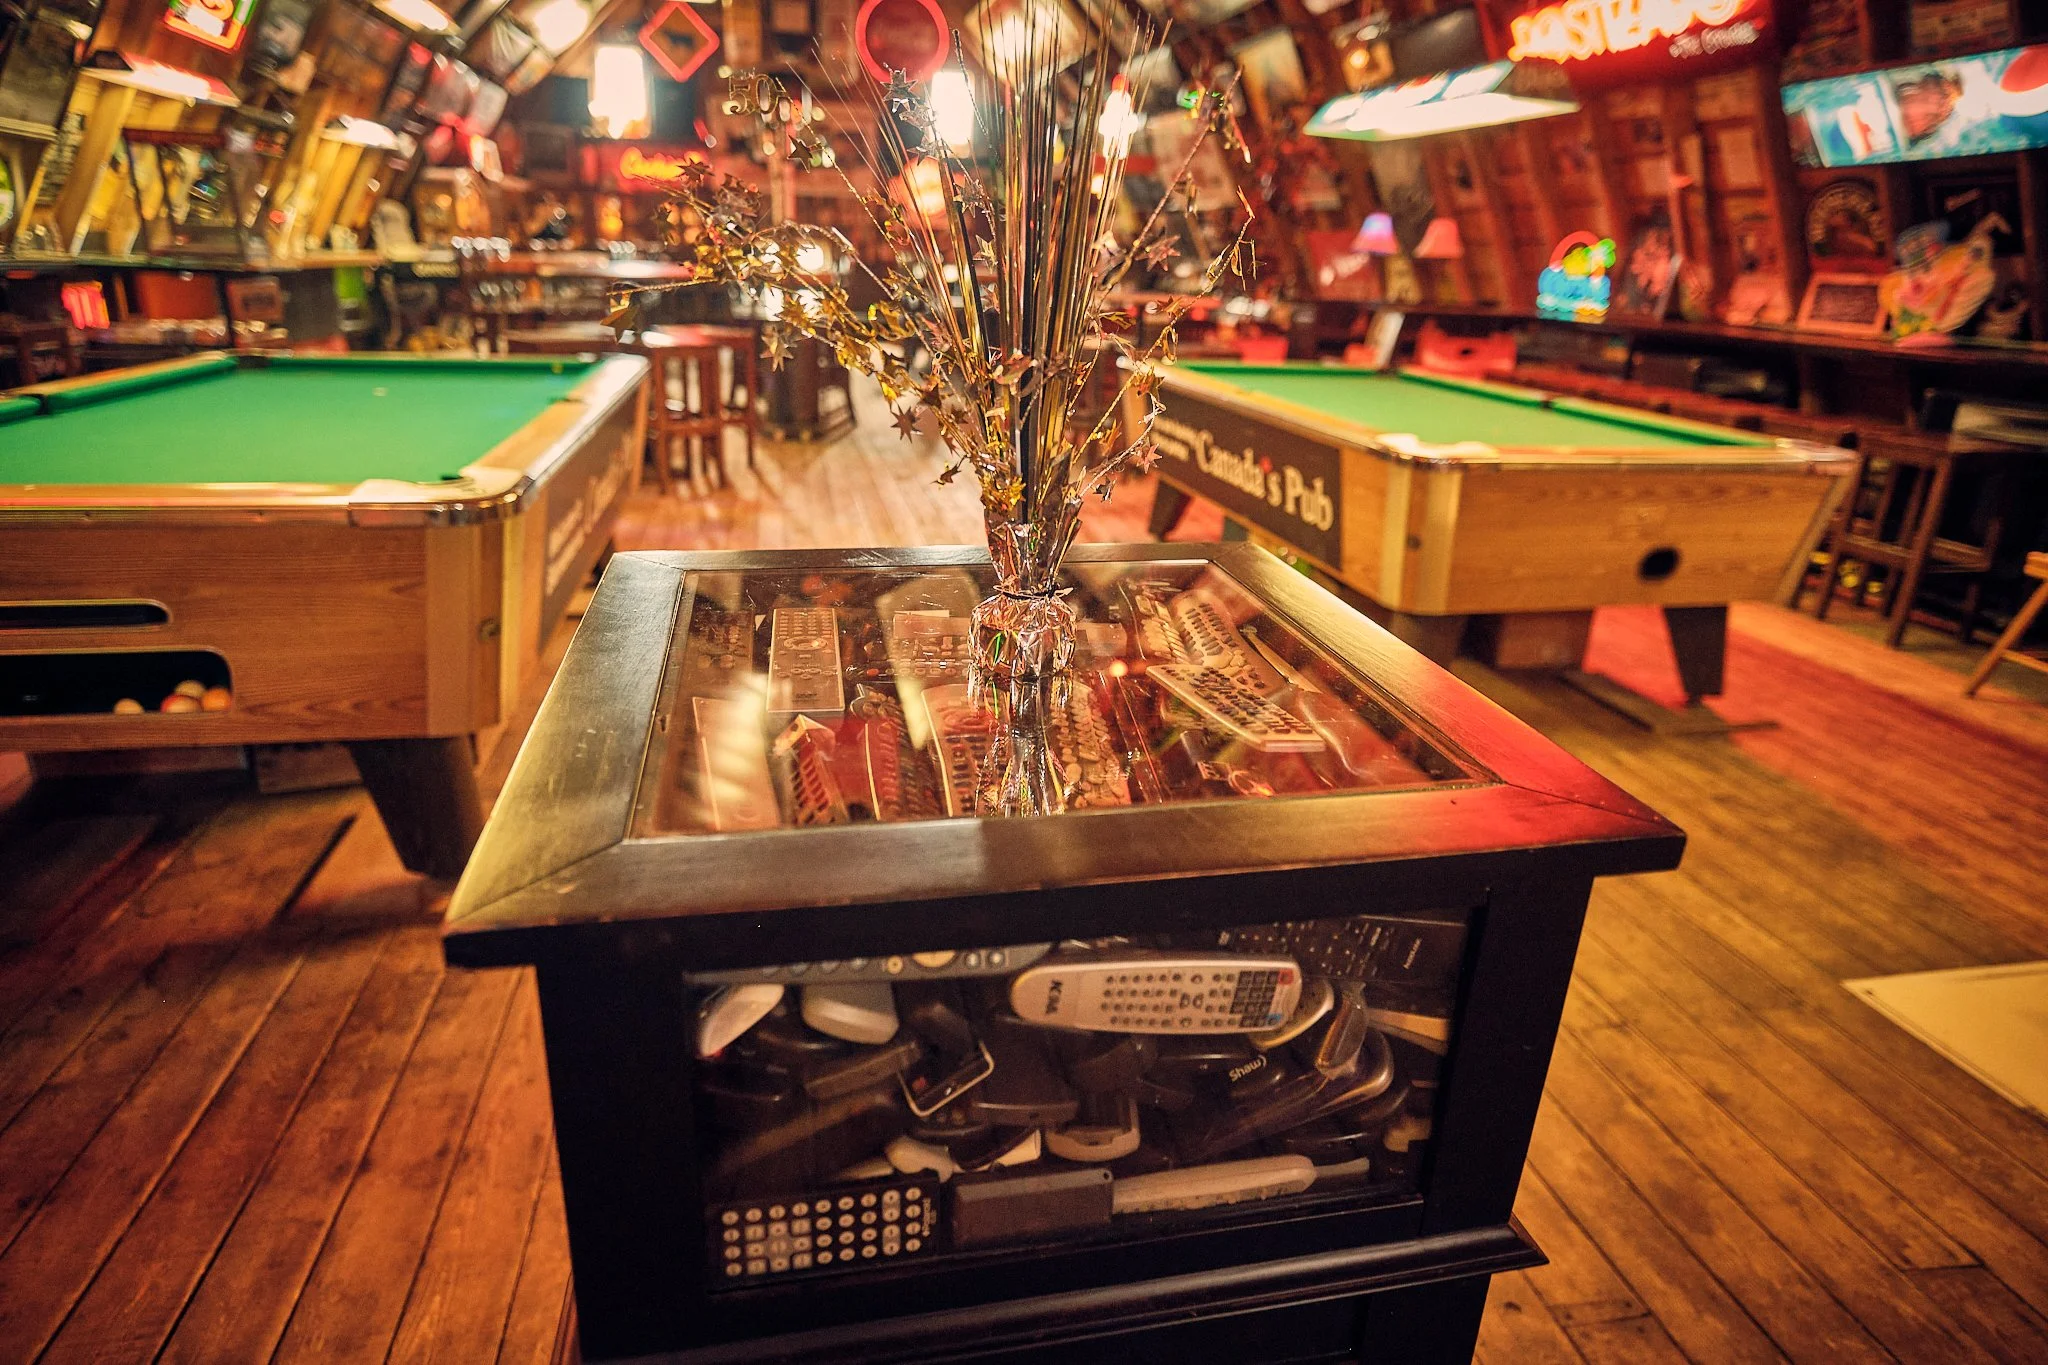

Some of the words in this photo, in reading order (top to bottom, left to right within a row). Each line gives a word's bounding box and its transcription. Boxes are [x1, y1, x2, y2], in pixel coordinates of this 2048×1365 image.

[729, 73, 778, 116] 50
[1195, 430, 1282, 507] Canada's
[1284, 465, 1334, 531] Pub
